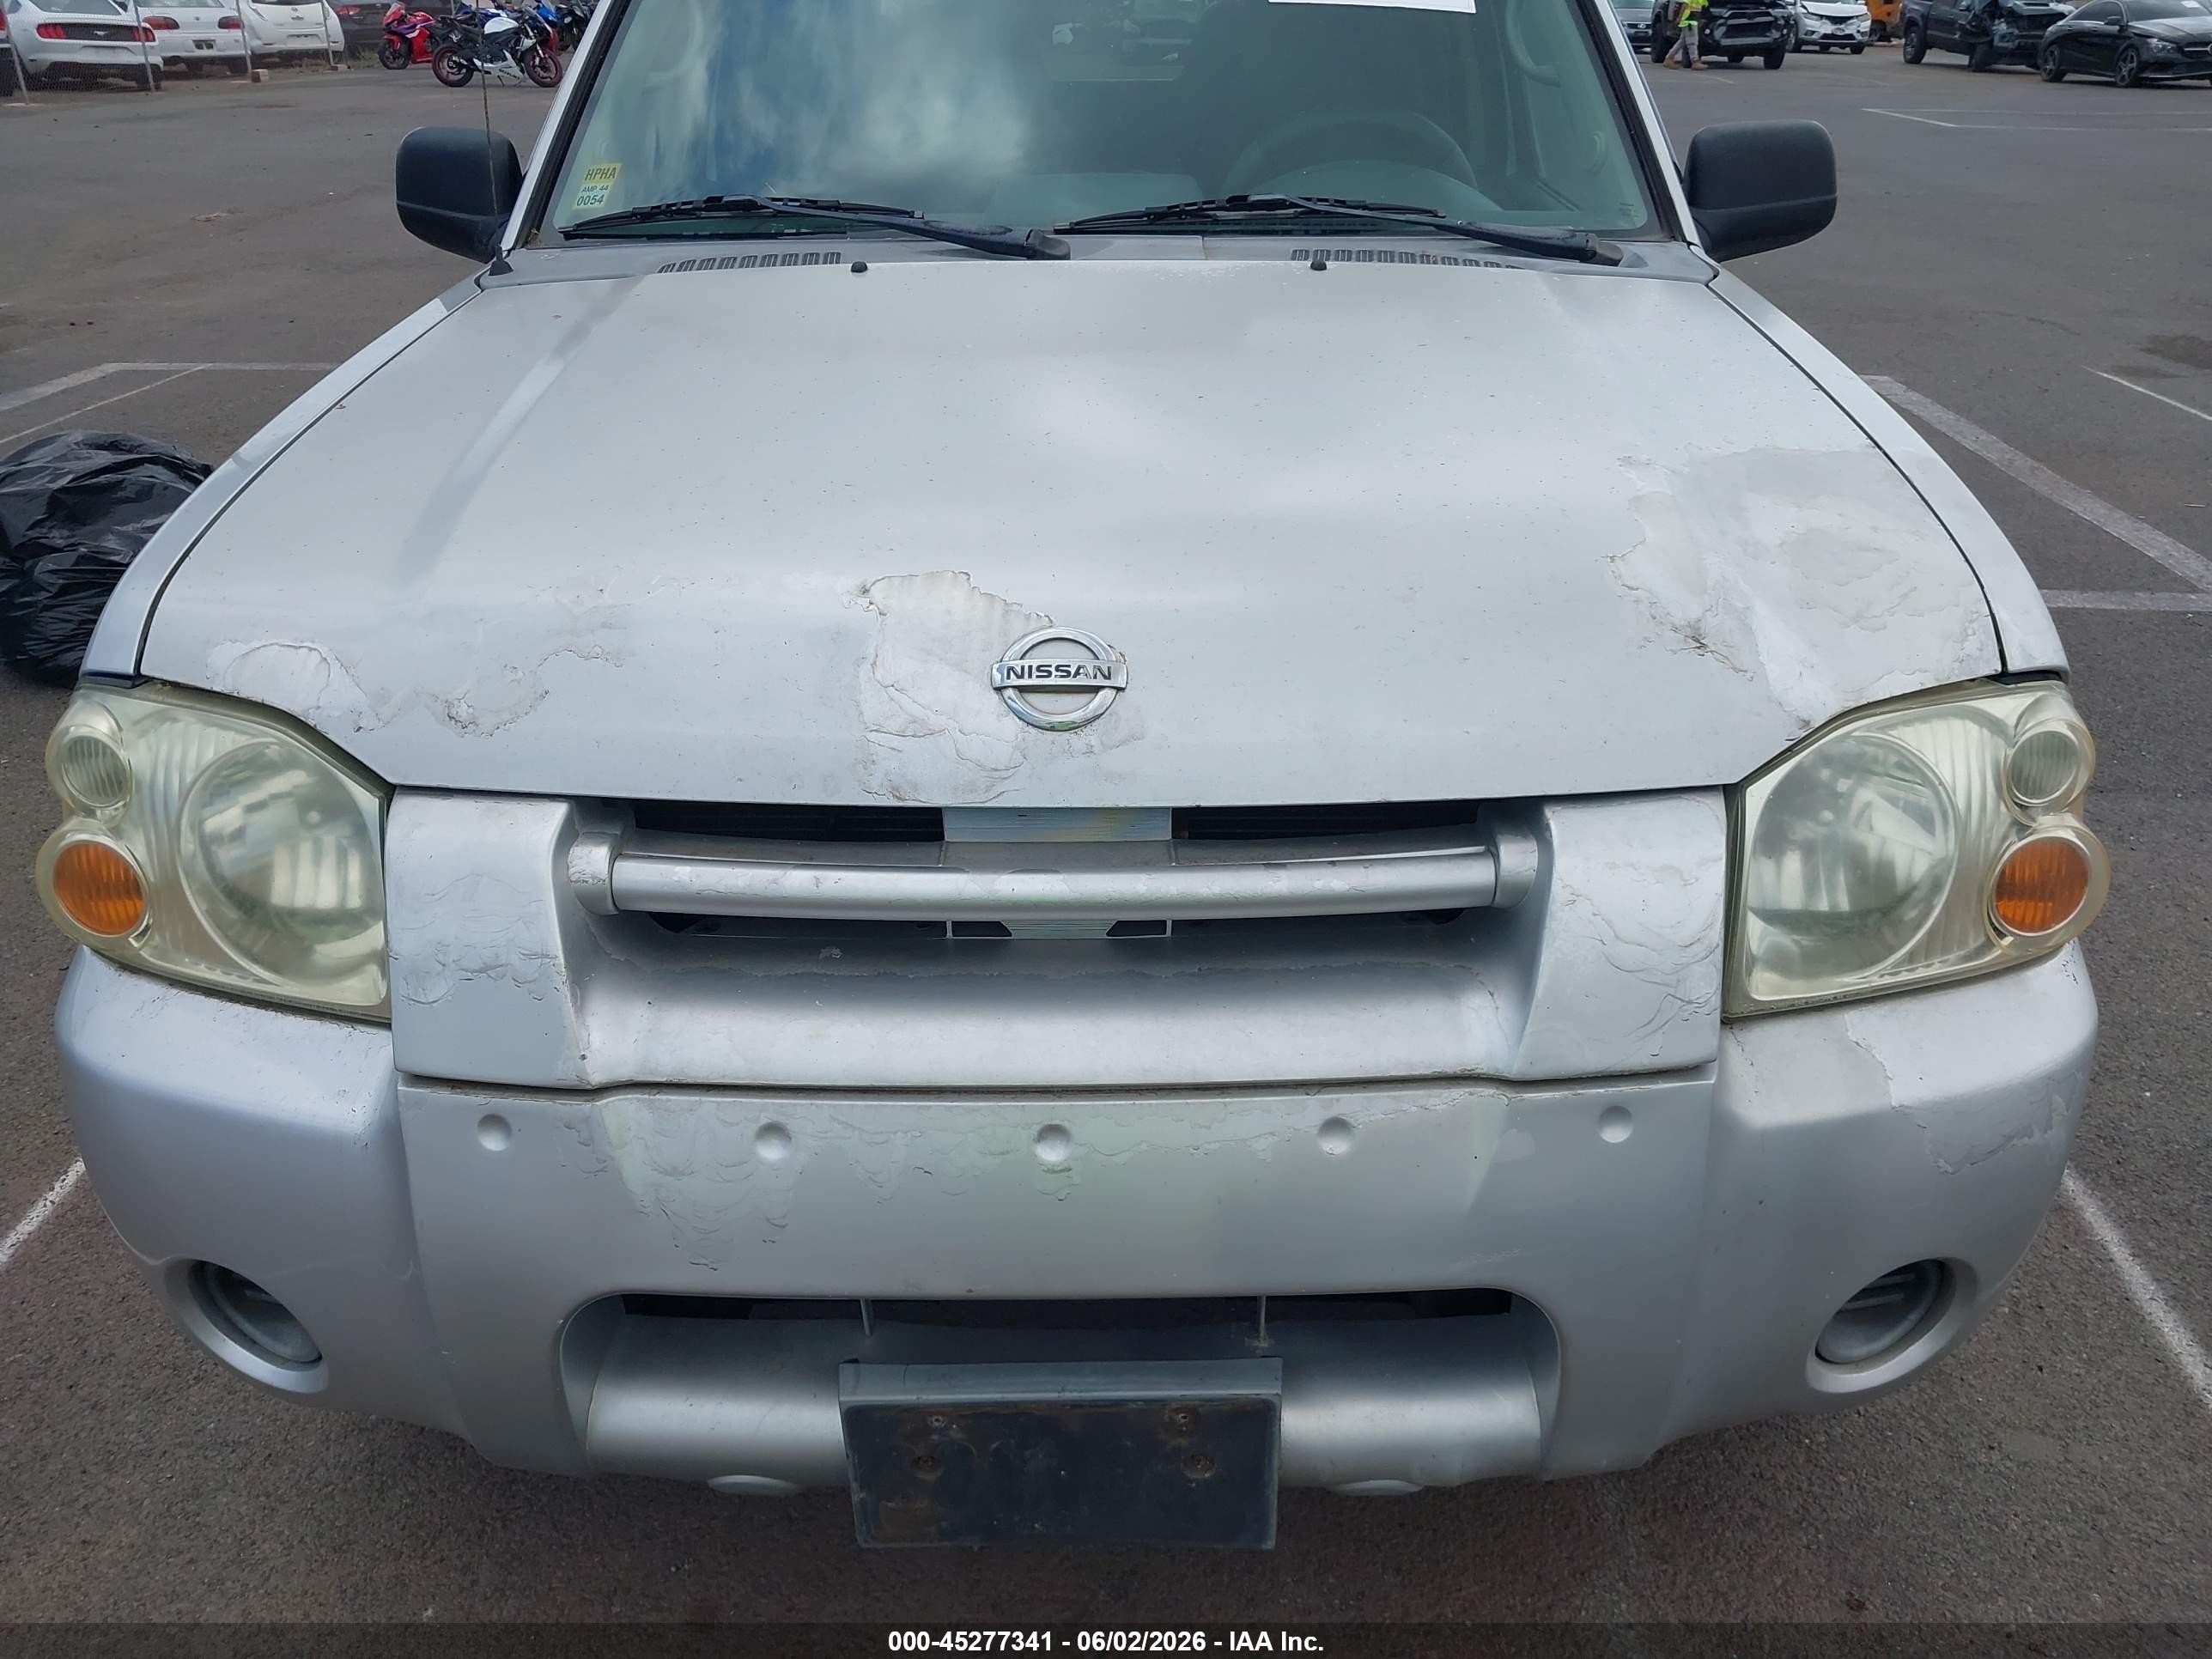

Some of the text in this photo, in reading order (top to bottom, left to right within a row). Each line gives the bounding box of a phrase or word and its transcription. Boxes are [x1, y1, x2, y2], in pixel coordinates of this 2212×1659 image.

[584, 167, 617, 180] HPHA
[576, 193, 605, 207] 0054
[1006, 664, 1112, 681] NISSAN
